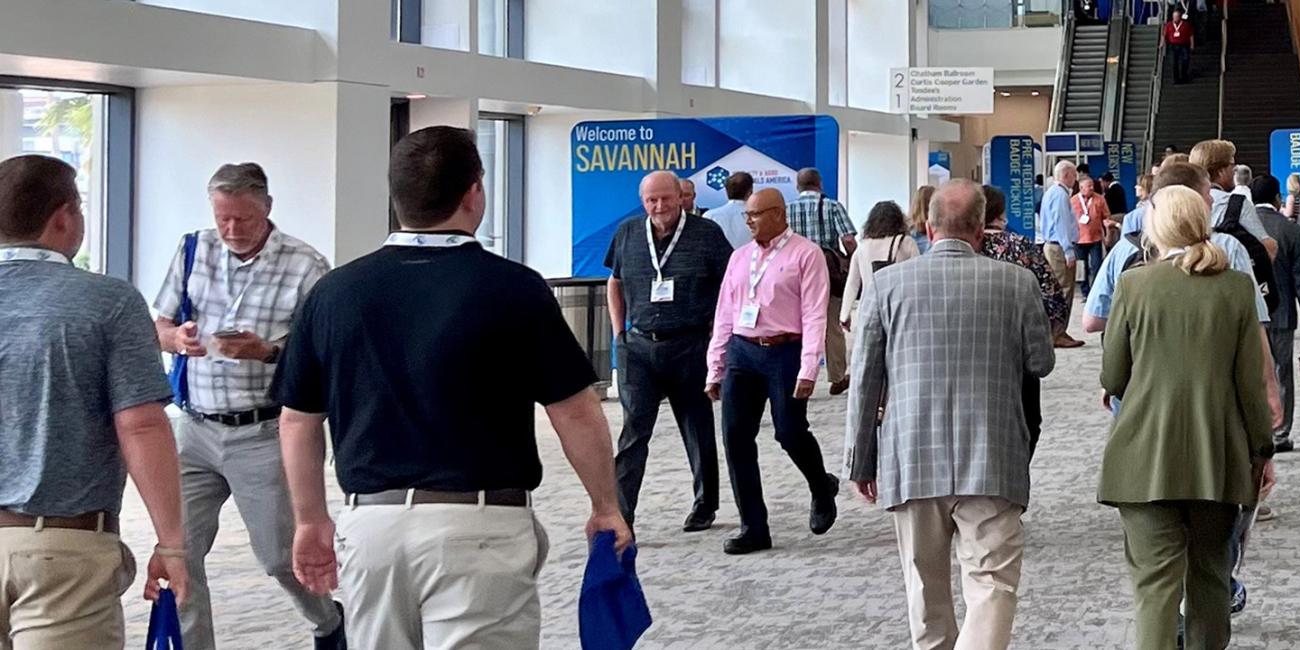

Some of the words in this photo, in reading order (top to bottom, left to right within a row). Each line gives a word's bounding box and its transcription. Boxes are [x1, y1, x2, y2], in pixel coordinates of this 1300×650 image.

[894, 73, 905, 88] 2
[896, 93, 901, 108] 1
[575, 126, 636, 141] Welcome
[639, 125, 653, 140] to
[576, 142, 696, 172] SAVANNAH
